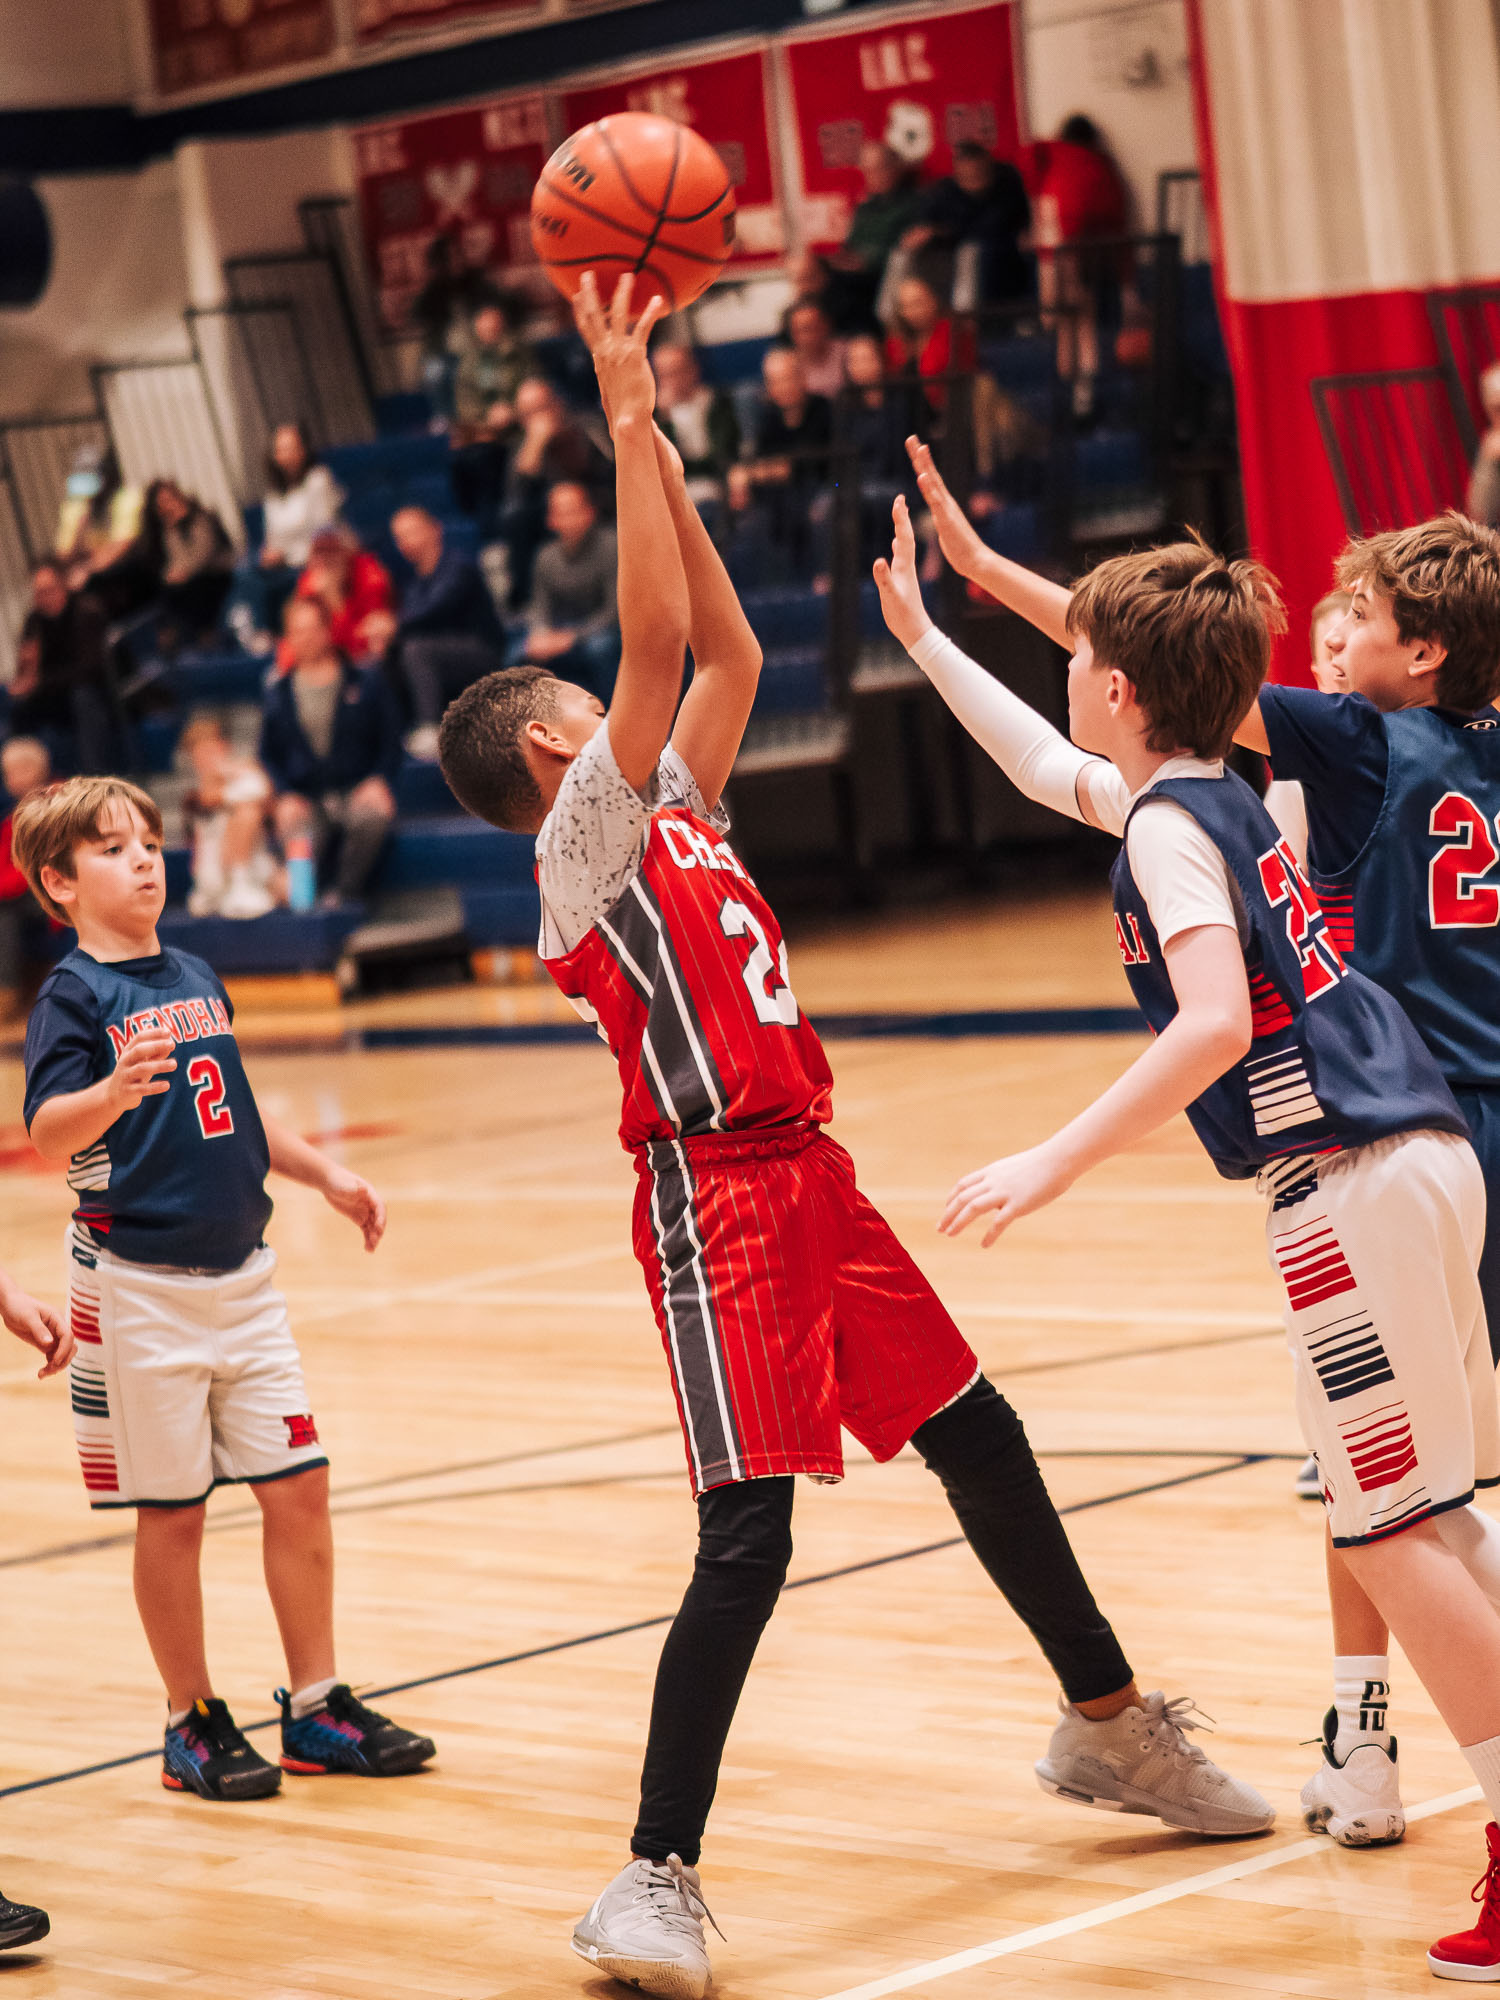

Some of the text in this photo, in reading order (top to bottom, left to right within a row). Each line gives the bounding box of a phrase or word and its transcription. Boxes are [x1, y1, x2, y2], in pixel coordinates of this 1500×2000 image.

[1428, 791, 1500, 930] 2
[106, 997, 234, 1062] MENDHA
[187, 1055, 235, 1140] 2
